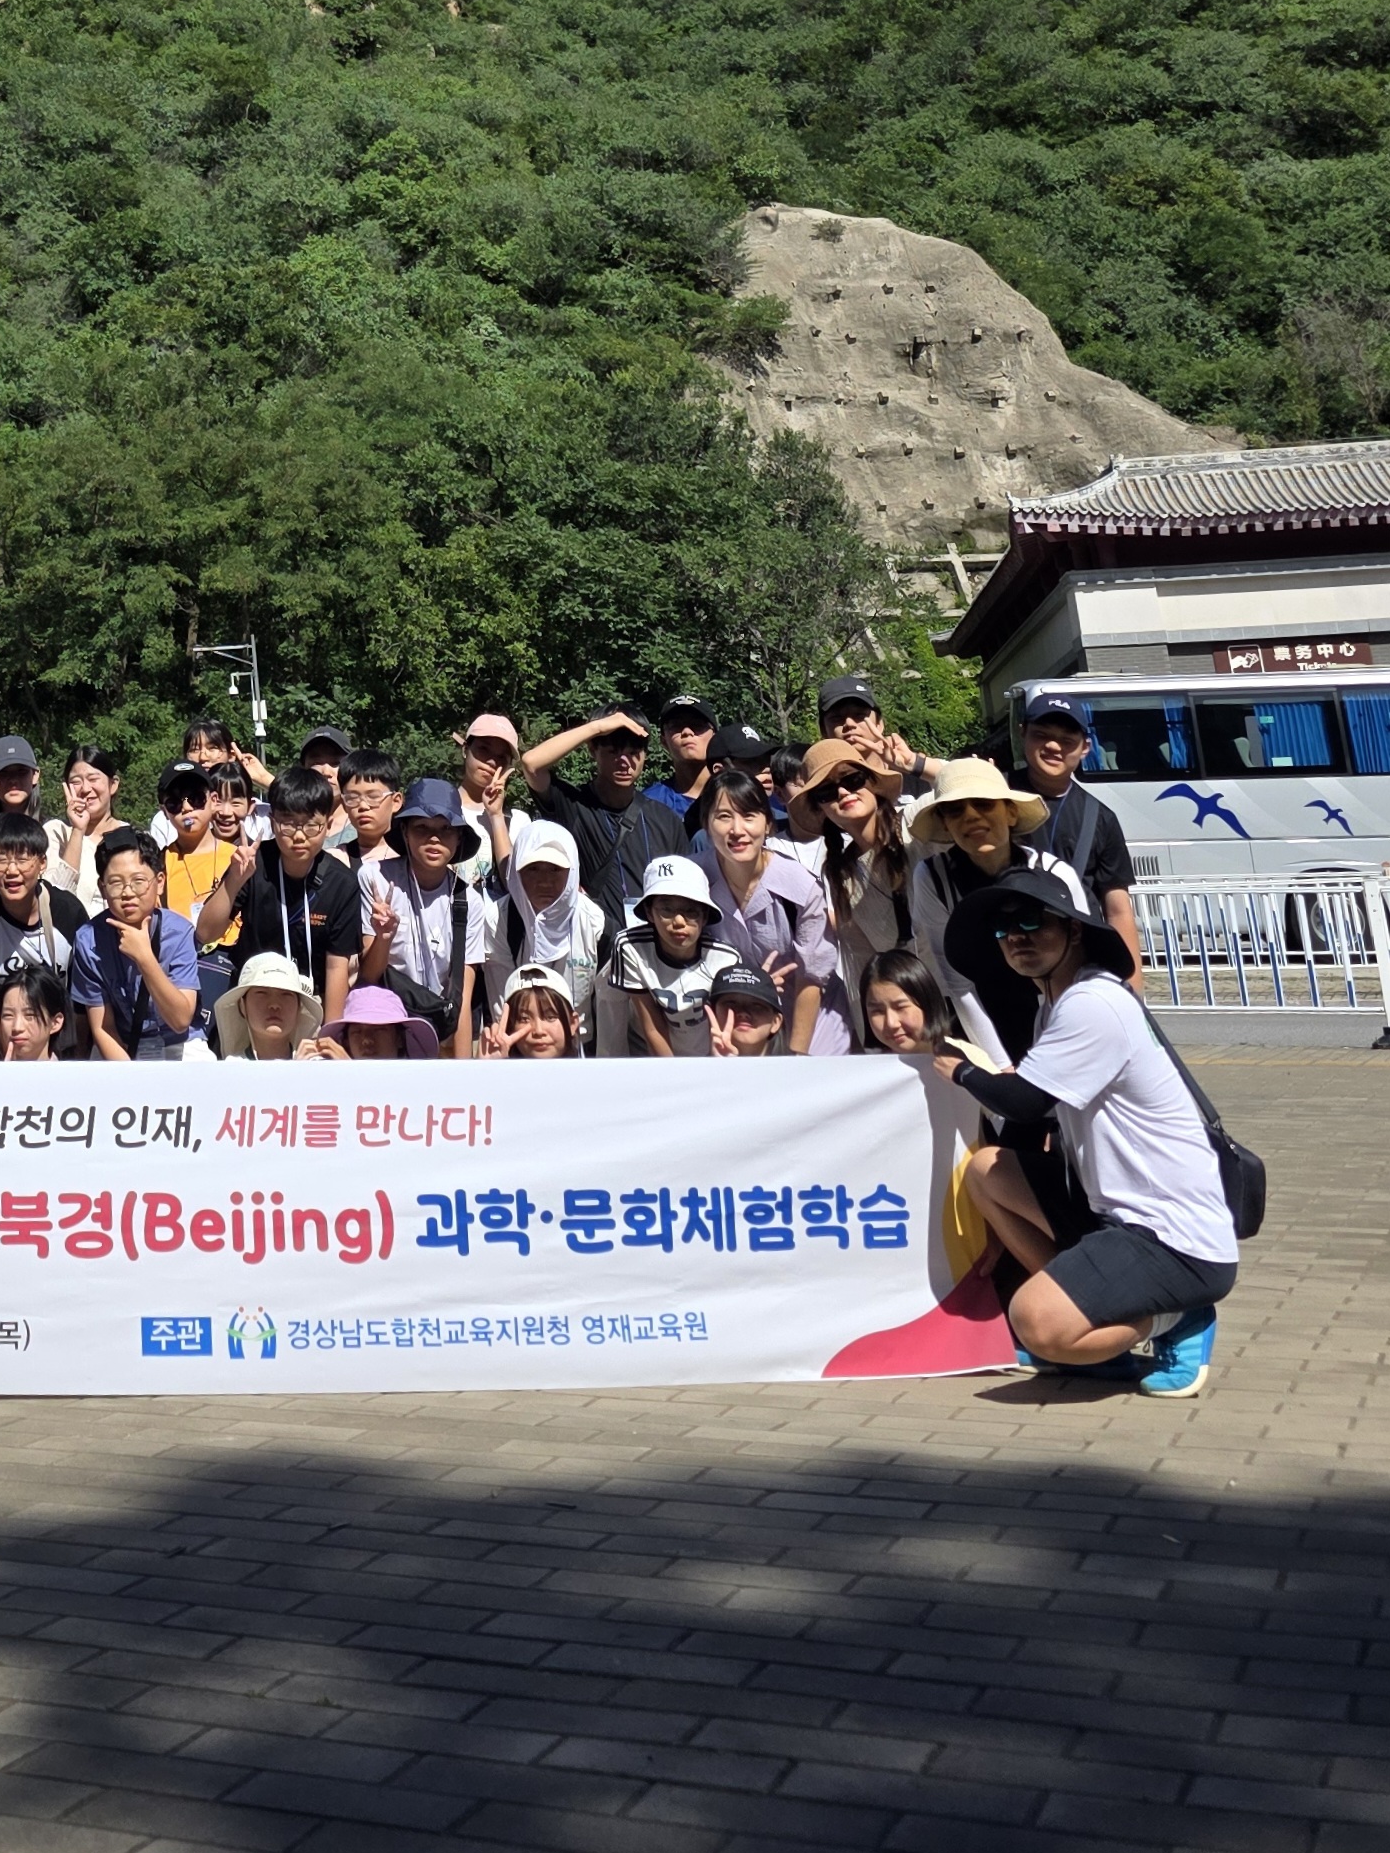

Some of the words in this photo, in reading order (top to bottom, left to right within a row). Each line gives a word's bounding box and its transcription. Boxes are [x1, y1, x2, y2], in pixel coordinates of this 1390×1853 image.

[1273, 642, 1356, 661] 票务中心
[111, 1105, 203, 1154] 인재,
[215, 1104, 342, 1149] 세계를
[355, 1104, 493, 1148] 만나다!
[415, 1183, 910, 1257] 과학·문화체험학습
[150, 1319, 204, 1351] 주관
[287, 1315, 571, 1350] 경상남도합천교육지원청
[581, 1311, 709, 1345] 영재교육원
